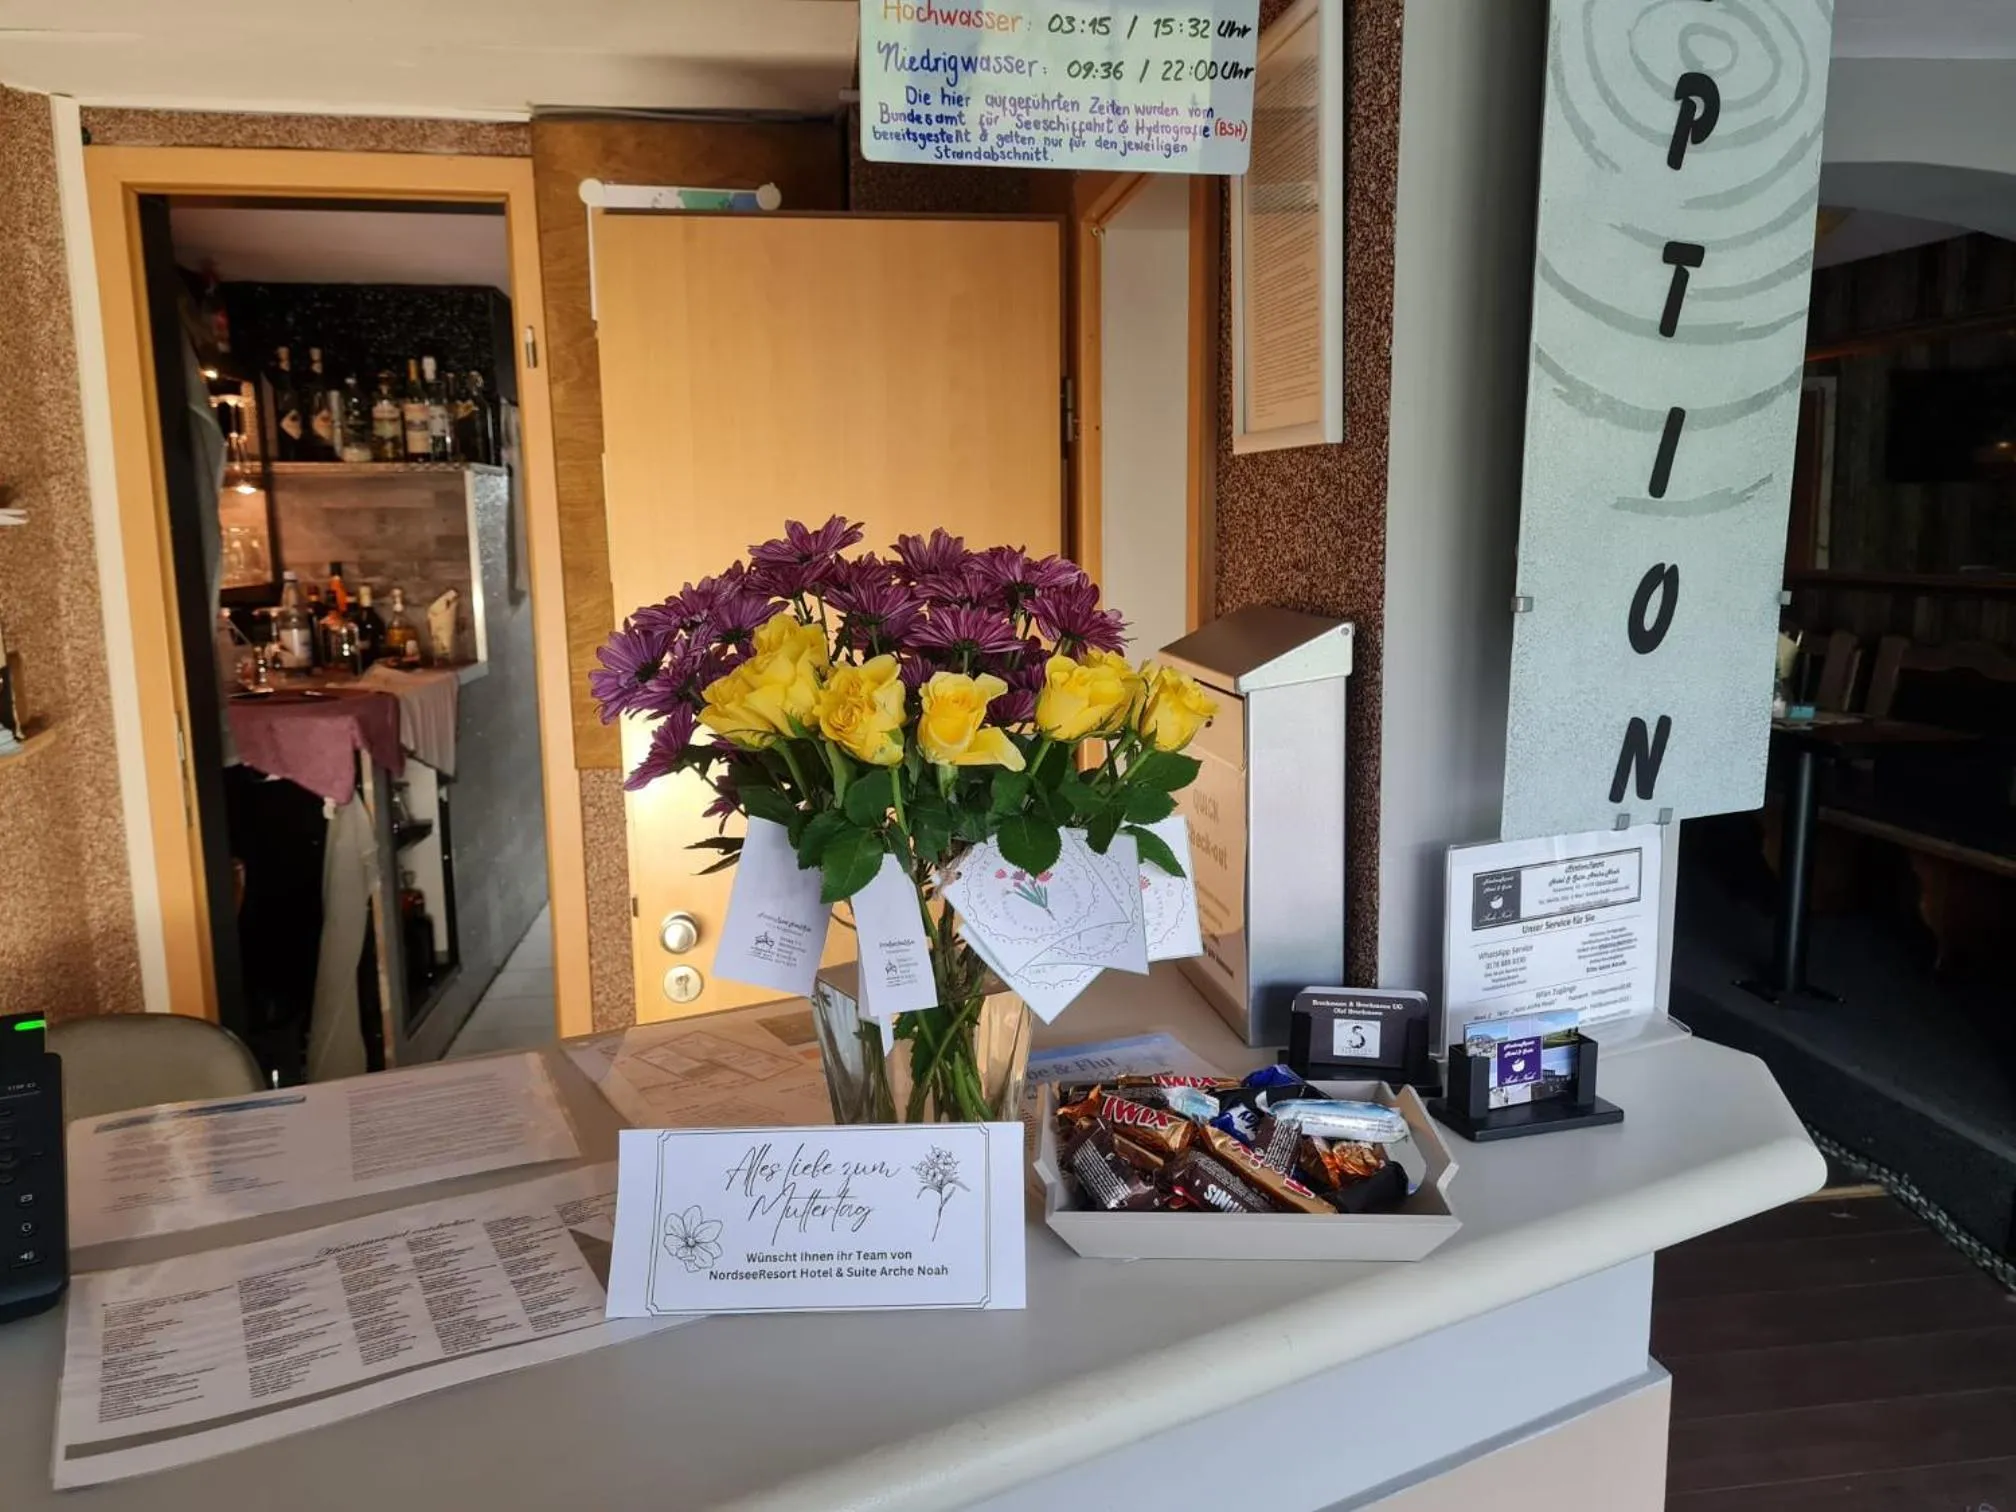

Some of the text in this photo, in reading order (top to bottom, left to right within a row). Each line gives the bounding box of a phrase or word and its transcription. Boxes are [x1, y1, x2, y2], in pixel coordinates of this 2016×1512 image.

[1047, 13, 1112, 35] 03:15
[1153, 17, 1211, 39] 15:32
[1217, 19, 1252, 38] Uhr
[1066, 59, 1124, 81] 09:36
[1161, 59, 1218, 82] 22:00
[1220, 60, 1254, 81] Uhr
[905, 85, 931, 106] Die
[941, 86, 971, 108] hier
[1089, 96, 1130, 116] Zeiten
[1134, 101, 1179, 118] wurden
[879, 101, 966, 127] Bundesamt
[978, 112, 1000, 131] für
[1214, 117, 1248, 143] (BSH)
[996, 130, 1035, 148] gelten
[1043, 136, 1064, 148] nur
[1069, 136, 1086, 153] für
[1095, 136, 1118, 150] den
[1608, 0, 1721, 804] PTION
[1545, 918, 1572, 930] Service
[1101, 1094, 1171, 1130] TWIX
[726, 1143, 782, 1198] Alles
[835, 1161, 902, 1194] zum
[748, 1181, 876, 1247] Muttertag
[746, 1250, 912, 1264] Wünscht Ihnen ihr Team von
[709, 1264, 949, 1281] NordseeResort Hotel & Suite Arche Noah
